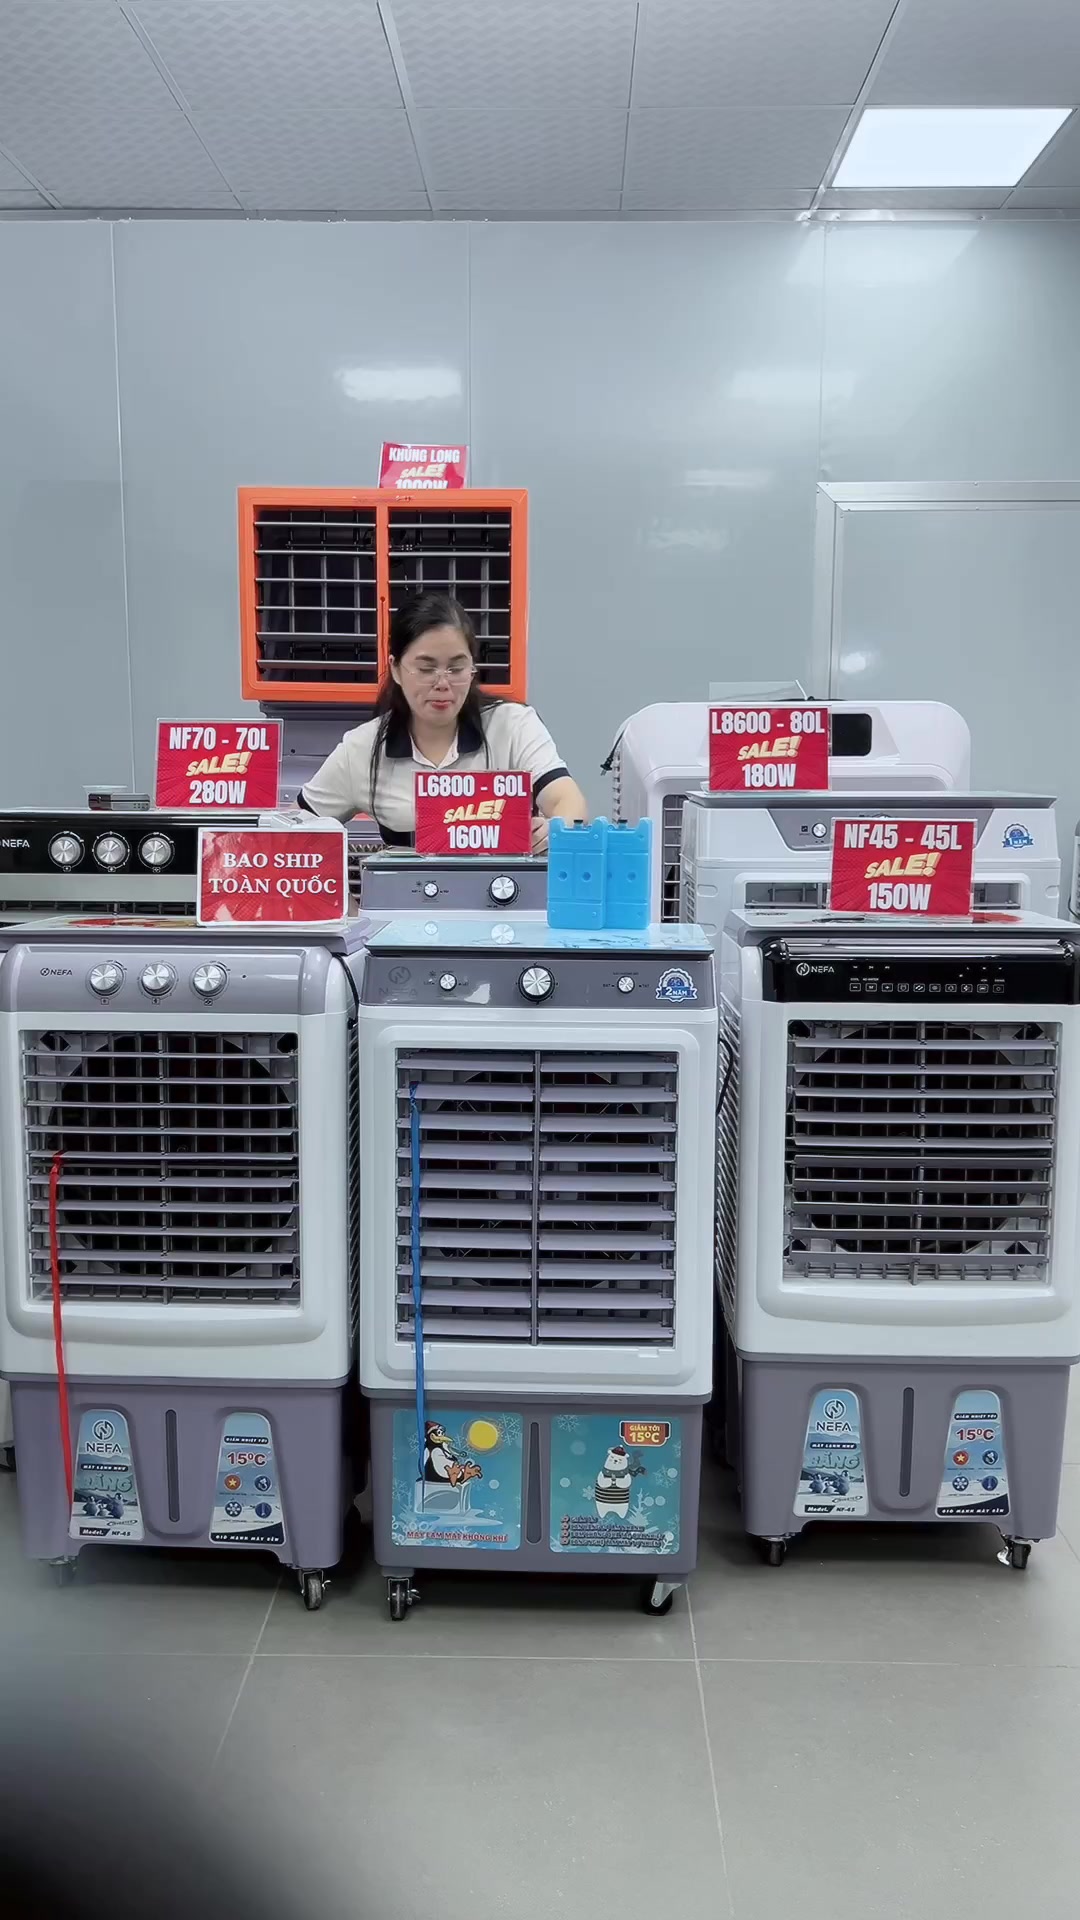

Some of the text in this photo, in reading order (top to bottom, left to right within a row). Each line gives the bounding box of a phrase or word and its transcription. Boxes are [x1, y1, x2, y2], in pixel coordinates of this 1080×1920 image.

[430, 449, 460, 463] LONG
[400, 464, 446, 478] SALE!
[712, 711, 770, 734] L8600
[790, 711, 825, 734] 80L
[169, 727, 216, 750] NF70
[236, 728, 270, 750] 70L
[737, 736, 802, 760] SALE!
[186, 752, 252, 776] SALE!
[742, 763, 796, 788] 180W
[189, 780, 246, 804] 280W
[418, 775, 474, 797] L6800
[494, 775, 526, 797] 60L
[443, 799, 506, 824] SALE!
[2, 839, 30, 848] NEFA
[447, 825, 500, 848] 160W
[844, 824, 898, 848] NF45
[920, 824, 962, 850] 45L
[224, 853, 324, 868] BAO SHIP
[864, 852, 942, 879] SALE!
[208, 874, 336, 898] TOÀN QUỐC
[868, 883, 932, 910] 150W
[666, 986, 672, 996] 2
[816, 1422, 852, 1432] NEFA
[86, 1442, 122, 1453] NEFA
